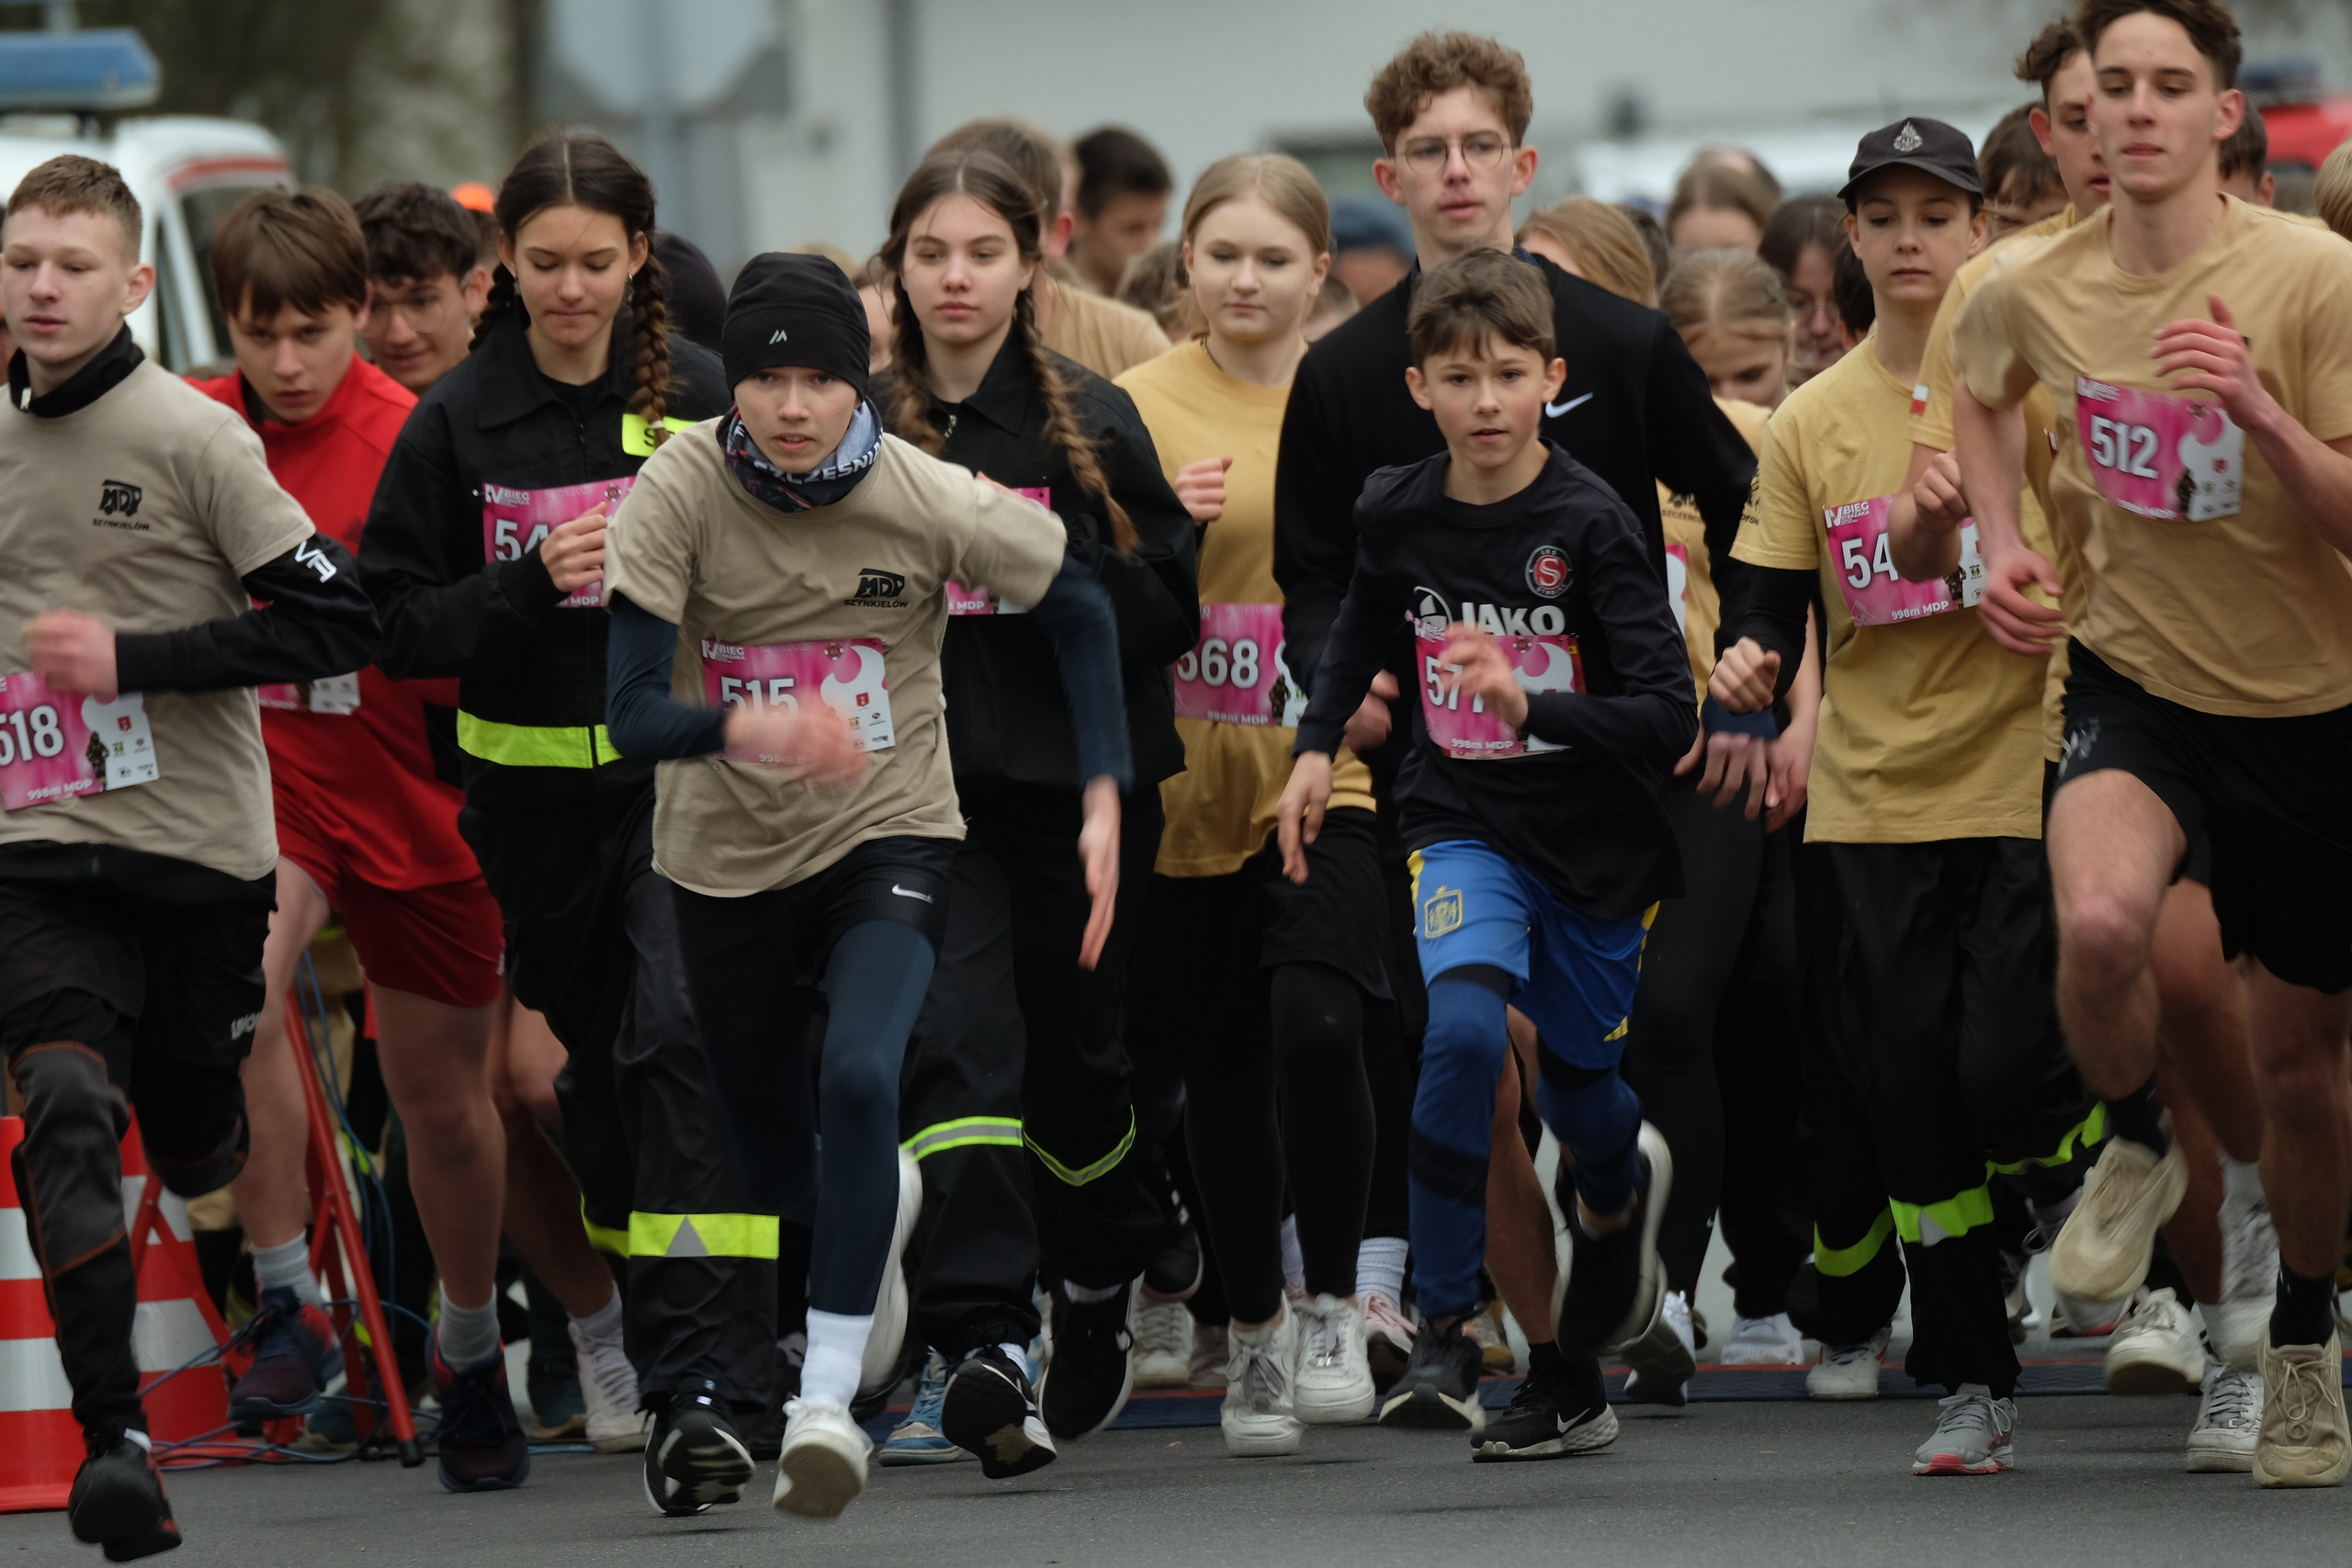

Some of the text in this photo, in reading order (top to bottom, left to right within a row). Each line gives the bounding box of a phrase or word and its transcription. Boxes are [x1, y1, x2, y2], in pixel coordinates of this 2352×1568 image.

[2090, 414, 2159, 479] 512
[1843, 501, 1870, 515] BIEG
[570, 596, 600, 606] MDP
[843, 599, 909, 608] SZYNKIELÓW
[956, 601, 985, 611] MDP
[1891, 600, 1950, 621] 998m MDP
[1461, 601, 1566, 637] JAKO
[718, 644, 745, 656] BIEG
[1177, 637, 1260, 689] 568
[1451, 738, 1514, 750] 998m MDP
